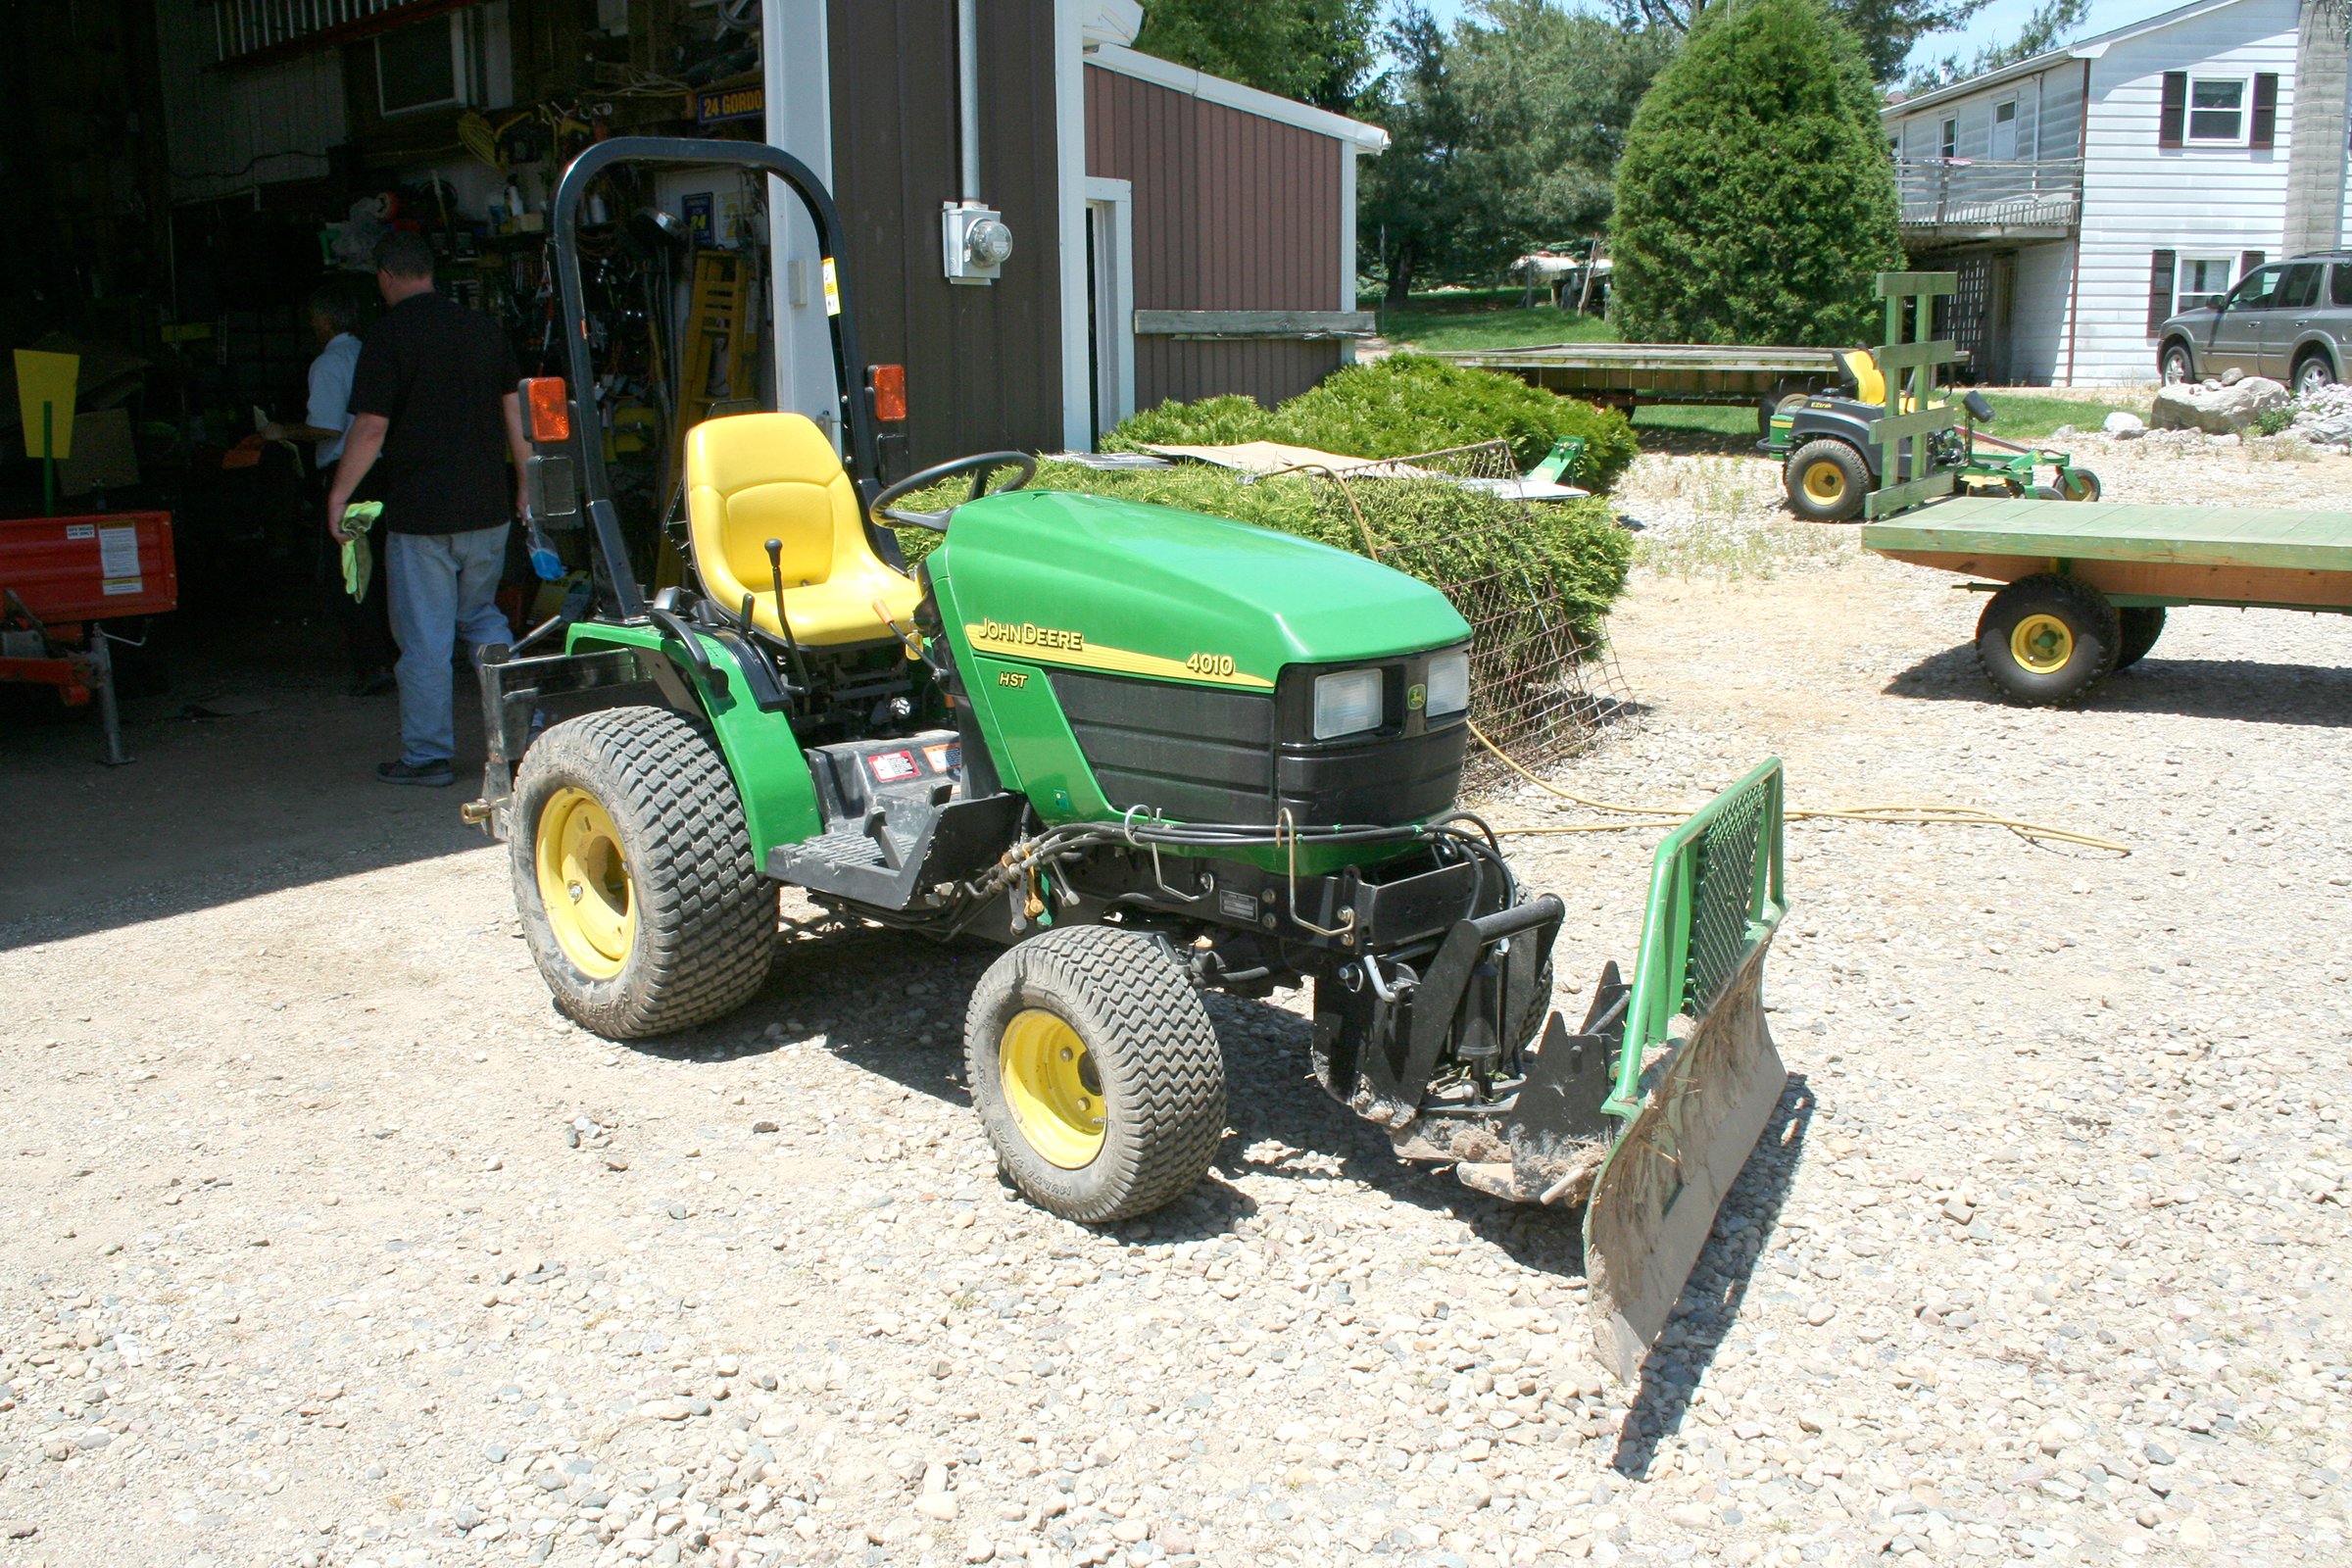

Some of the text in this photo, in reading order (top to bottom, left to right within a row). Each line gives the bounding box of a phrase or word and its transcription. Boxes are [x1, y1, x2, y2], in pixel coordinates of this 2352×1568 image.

[705, 98, 719, 119] 24
[979, 617, 1083, 651] JOHN DEERE
[1186, 653, 1235, 676] 4010
[1000, 672, 1028, 688] HST
[1028, 1169, 1072, 1197] MULTI
